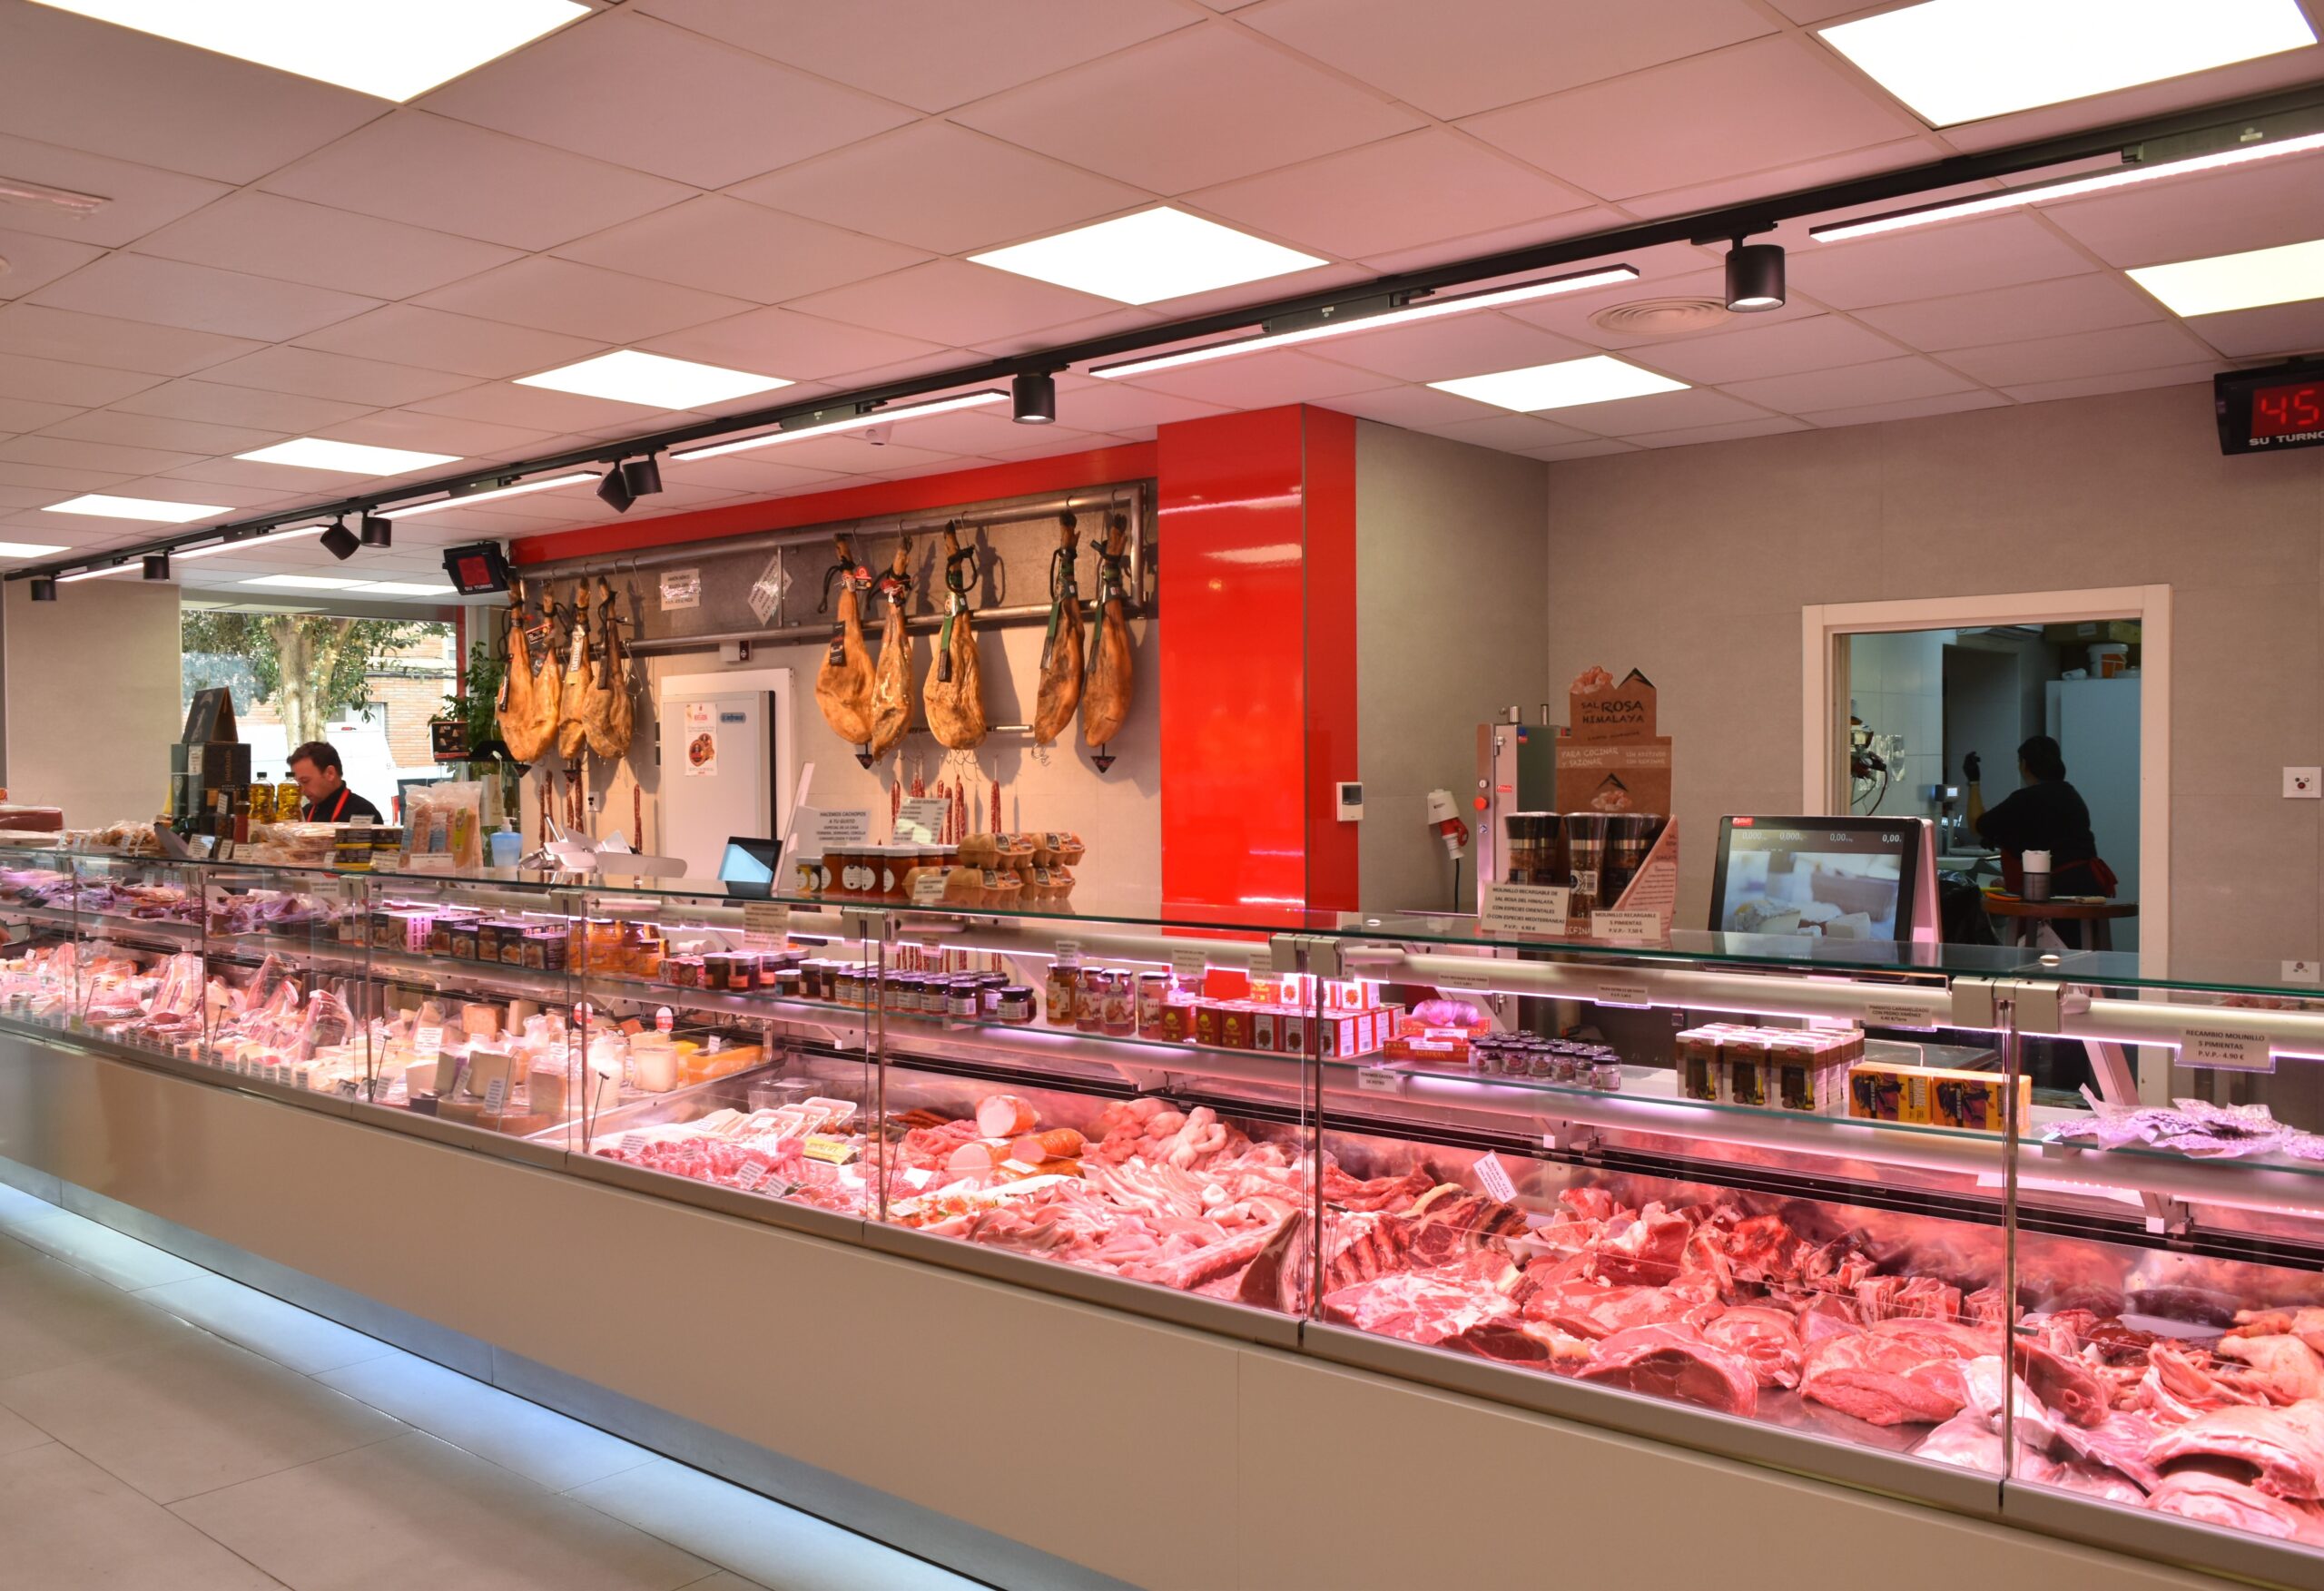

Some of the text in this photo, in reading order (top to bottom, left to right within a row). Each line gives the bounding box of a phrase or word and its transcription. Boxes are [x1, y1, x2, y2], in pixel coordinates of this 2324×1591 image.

[2260, 388, 2319, 426] 45
[2249, 437, 2270, 446] SU
[1581, 700, 1644, 713] SAL ROSA
[1582, 714, 1645, 724] HIMALAYA
[1583, 747, 1620, 757] COCINAR
[1882, 834, 1900, 843] 0,00
[2185, 1029, 2265, 1042] RECAMBIO MOLINILLO
[2204, 1041, 2244, 1050] PIMIENTAS
